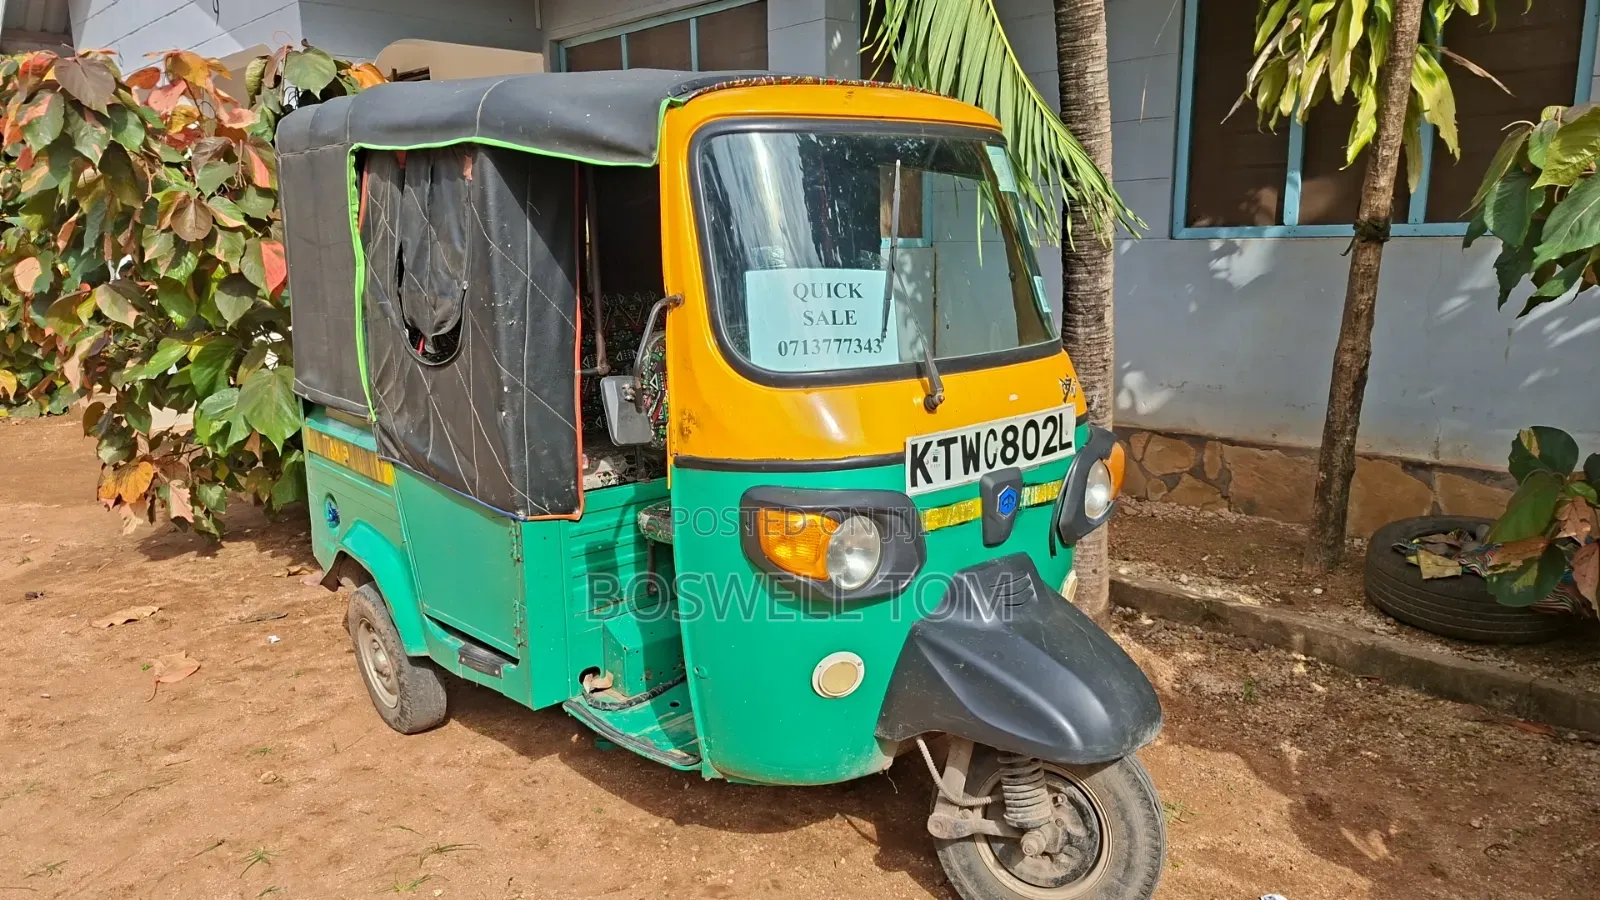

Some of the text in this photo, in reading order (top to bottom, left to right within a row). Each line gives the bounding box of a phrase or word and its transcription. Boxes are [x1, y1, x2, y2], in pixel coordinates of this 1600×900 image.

[793, 282, 863, 303] QUICK
[803, 309, 858, 326] SALE
[777, 337, 883, 356] 0713777343
[910, 412, 1072, 488] KTWC802L
